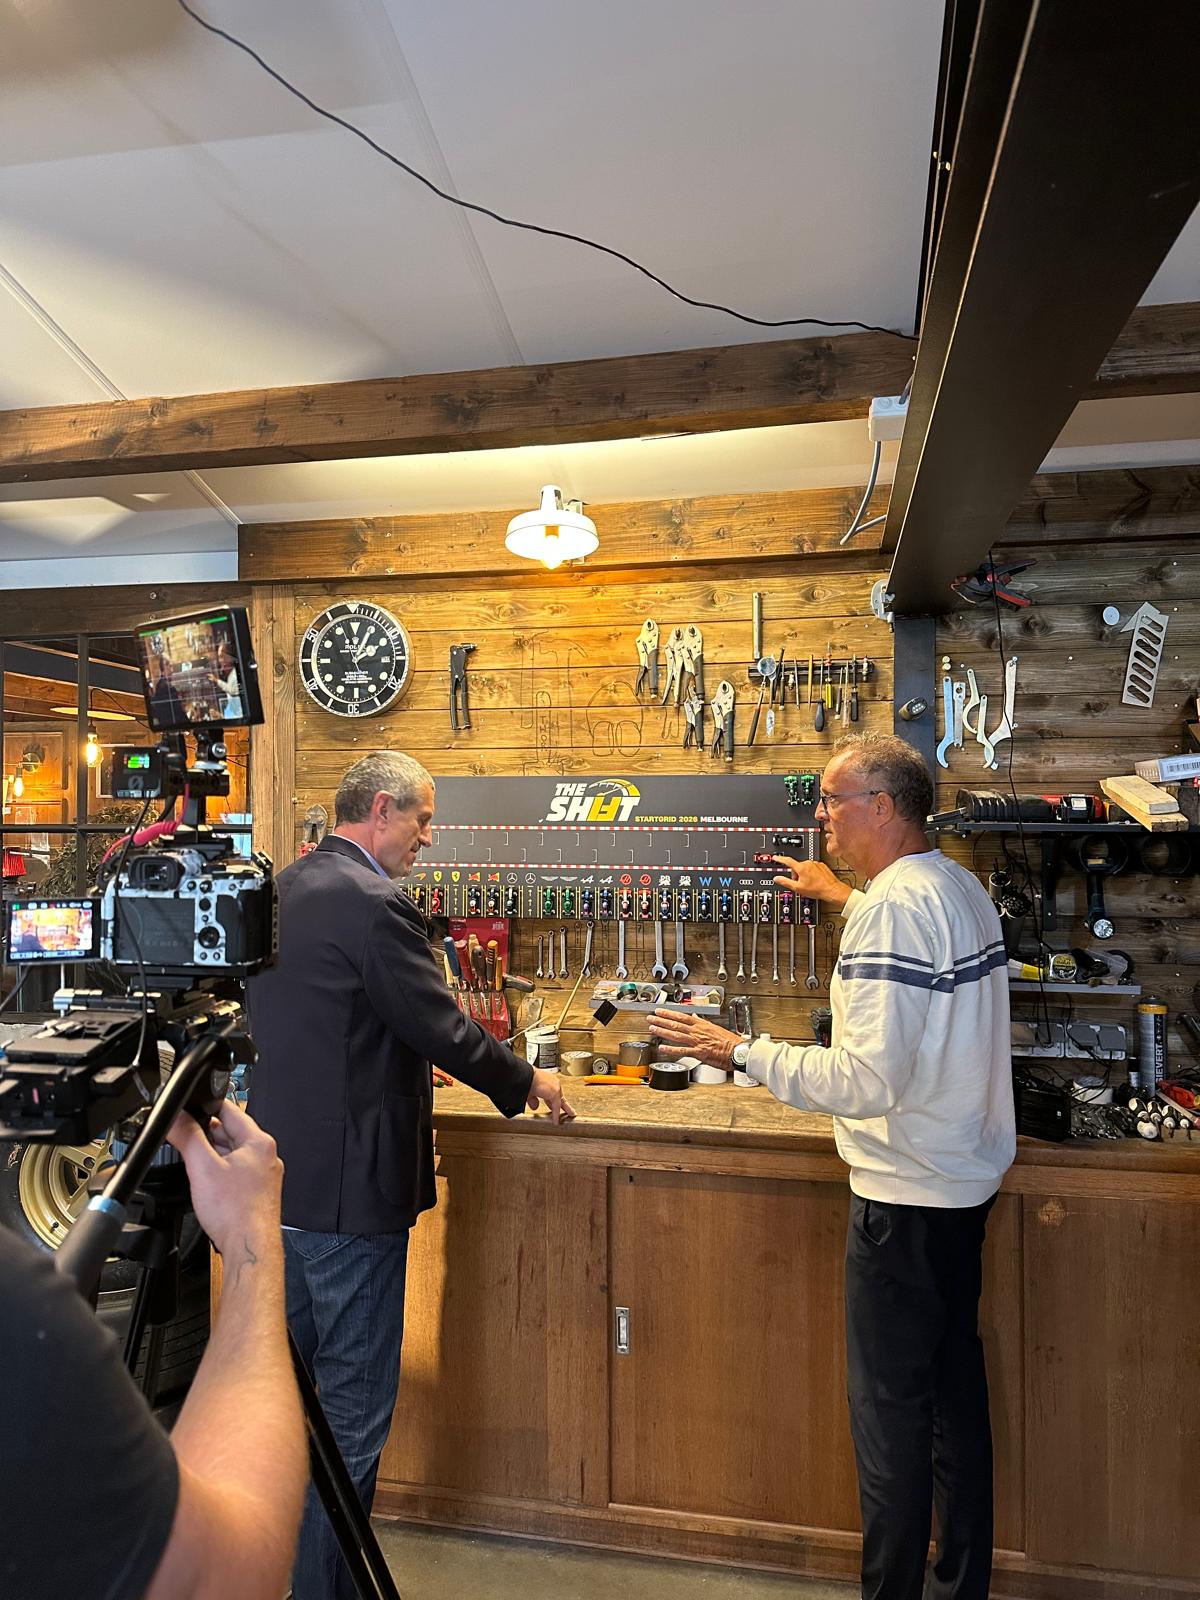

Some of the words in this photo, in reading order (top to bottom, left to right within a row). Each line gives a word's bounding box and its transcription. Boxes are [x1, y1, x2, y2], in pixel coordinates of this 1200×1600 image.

[347, 703, 360, 714] 30
[554, 783, 588, 796] THE
[634, 815, 677, 823] STARTGRID
[678, 815, 698, 823] 2026
[700, 815, 749, 823] MELBOURNE
[1155, 1043, 1164, 1083] SIEVERT
